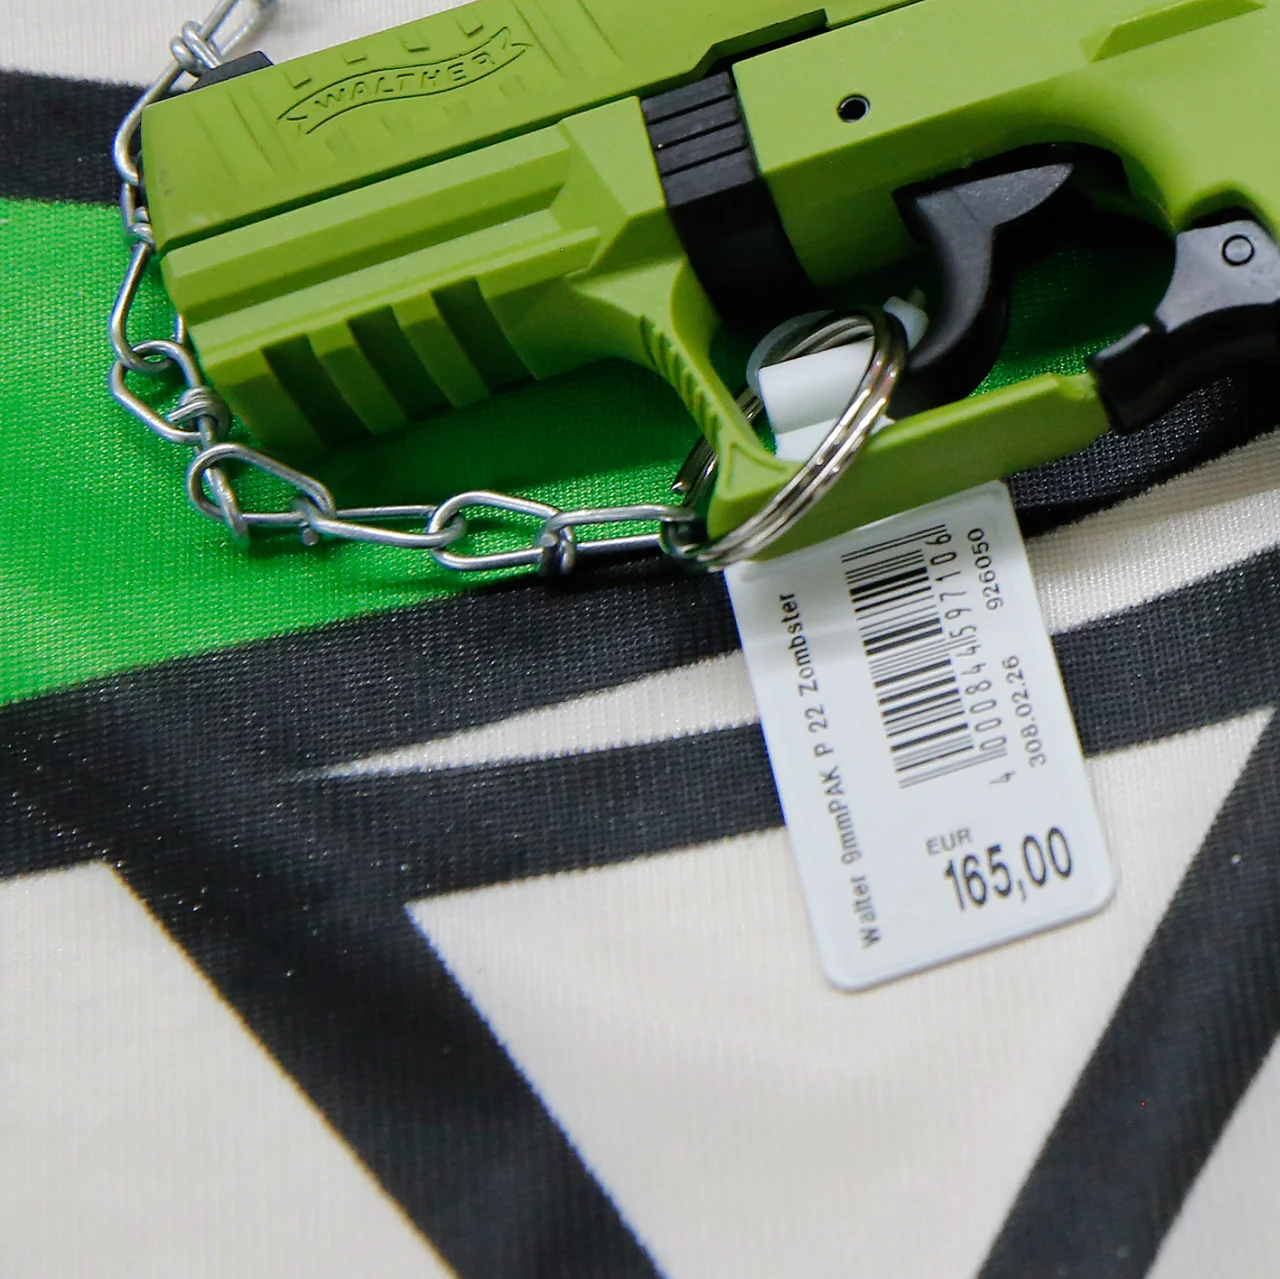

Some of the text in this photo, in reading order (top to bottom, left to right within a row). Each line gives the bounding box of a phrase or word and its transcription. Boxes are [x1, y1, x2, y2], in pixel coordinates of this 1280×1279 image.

[312, 50, 499, 111] WALTHER
[966, 528, 1046, 768] 308.02.26 926050
[779, 592, 882, 950] Walter 9mmPAK P 22 Zombster
[925, 828, 973, 856] EUR
[944, 826, 1073, 912] 165,00
